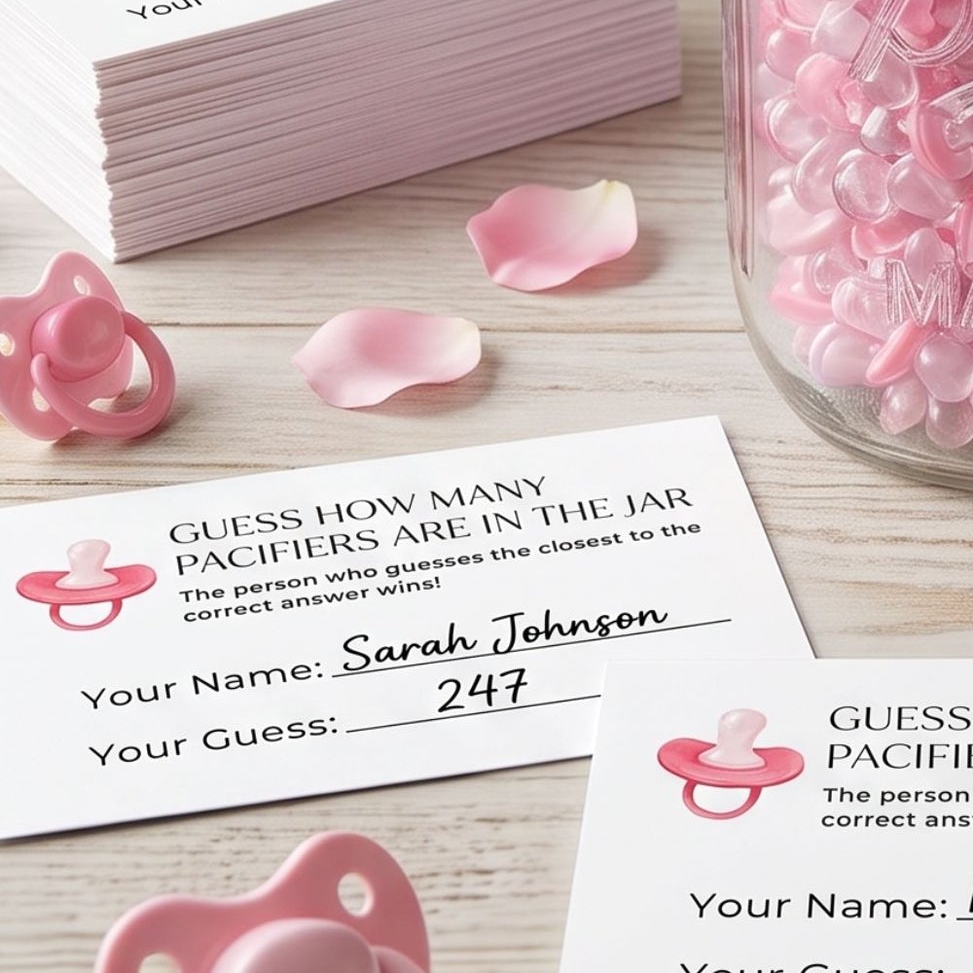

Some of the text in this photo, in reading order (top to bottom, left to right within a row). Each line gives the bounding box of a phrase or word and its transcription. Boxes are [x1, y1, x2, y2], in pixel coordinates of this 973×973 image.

[170, 476, 545, 544] GUESS HOW MANY
[176, 488, 693, 575] PACIFIERS ARE IN THE JAR
[179, 524, 700, 602] The person who guesses the closest to the
[184, 576, 441, 622] correct answer wins!
[343, 607, 668, 673] Sarah Johnson
[81, 662, 323, 709] Your Name:
[437, 668, 529, 713] 247
[89, 717, 337, 766] Your Guess:
[830, 706, 971, 731] GUESS
[823, 787, 870, 803] The
[880, 791, 969, 806] person
[821, 813, 916, 827] correct
[690, 893, 946, 918] Your Name:
